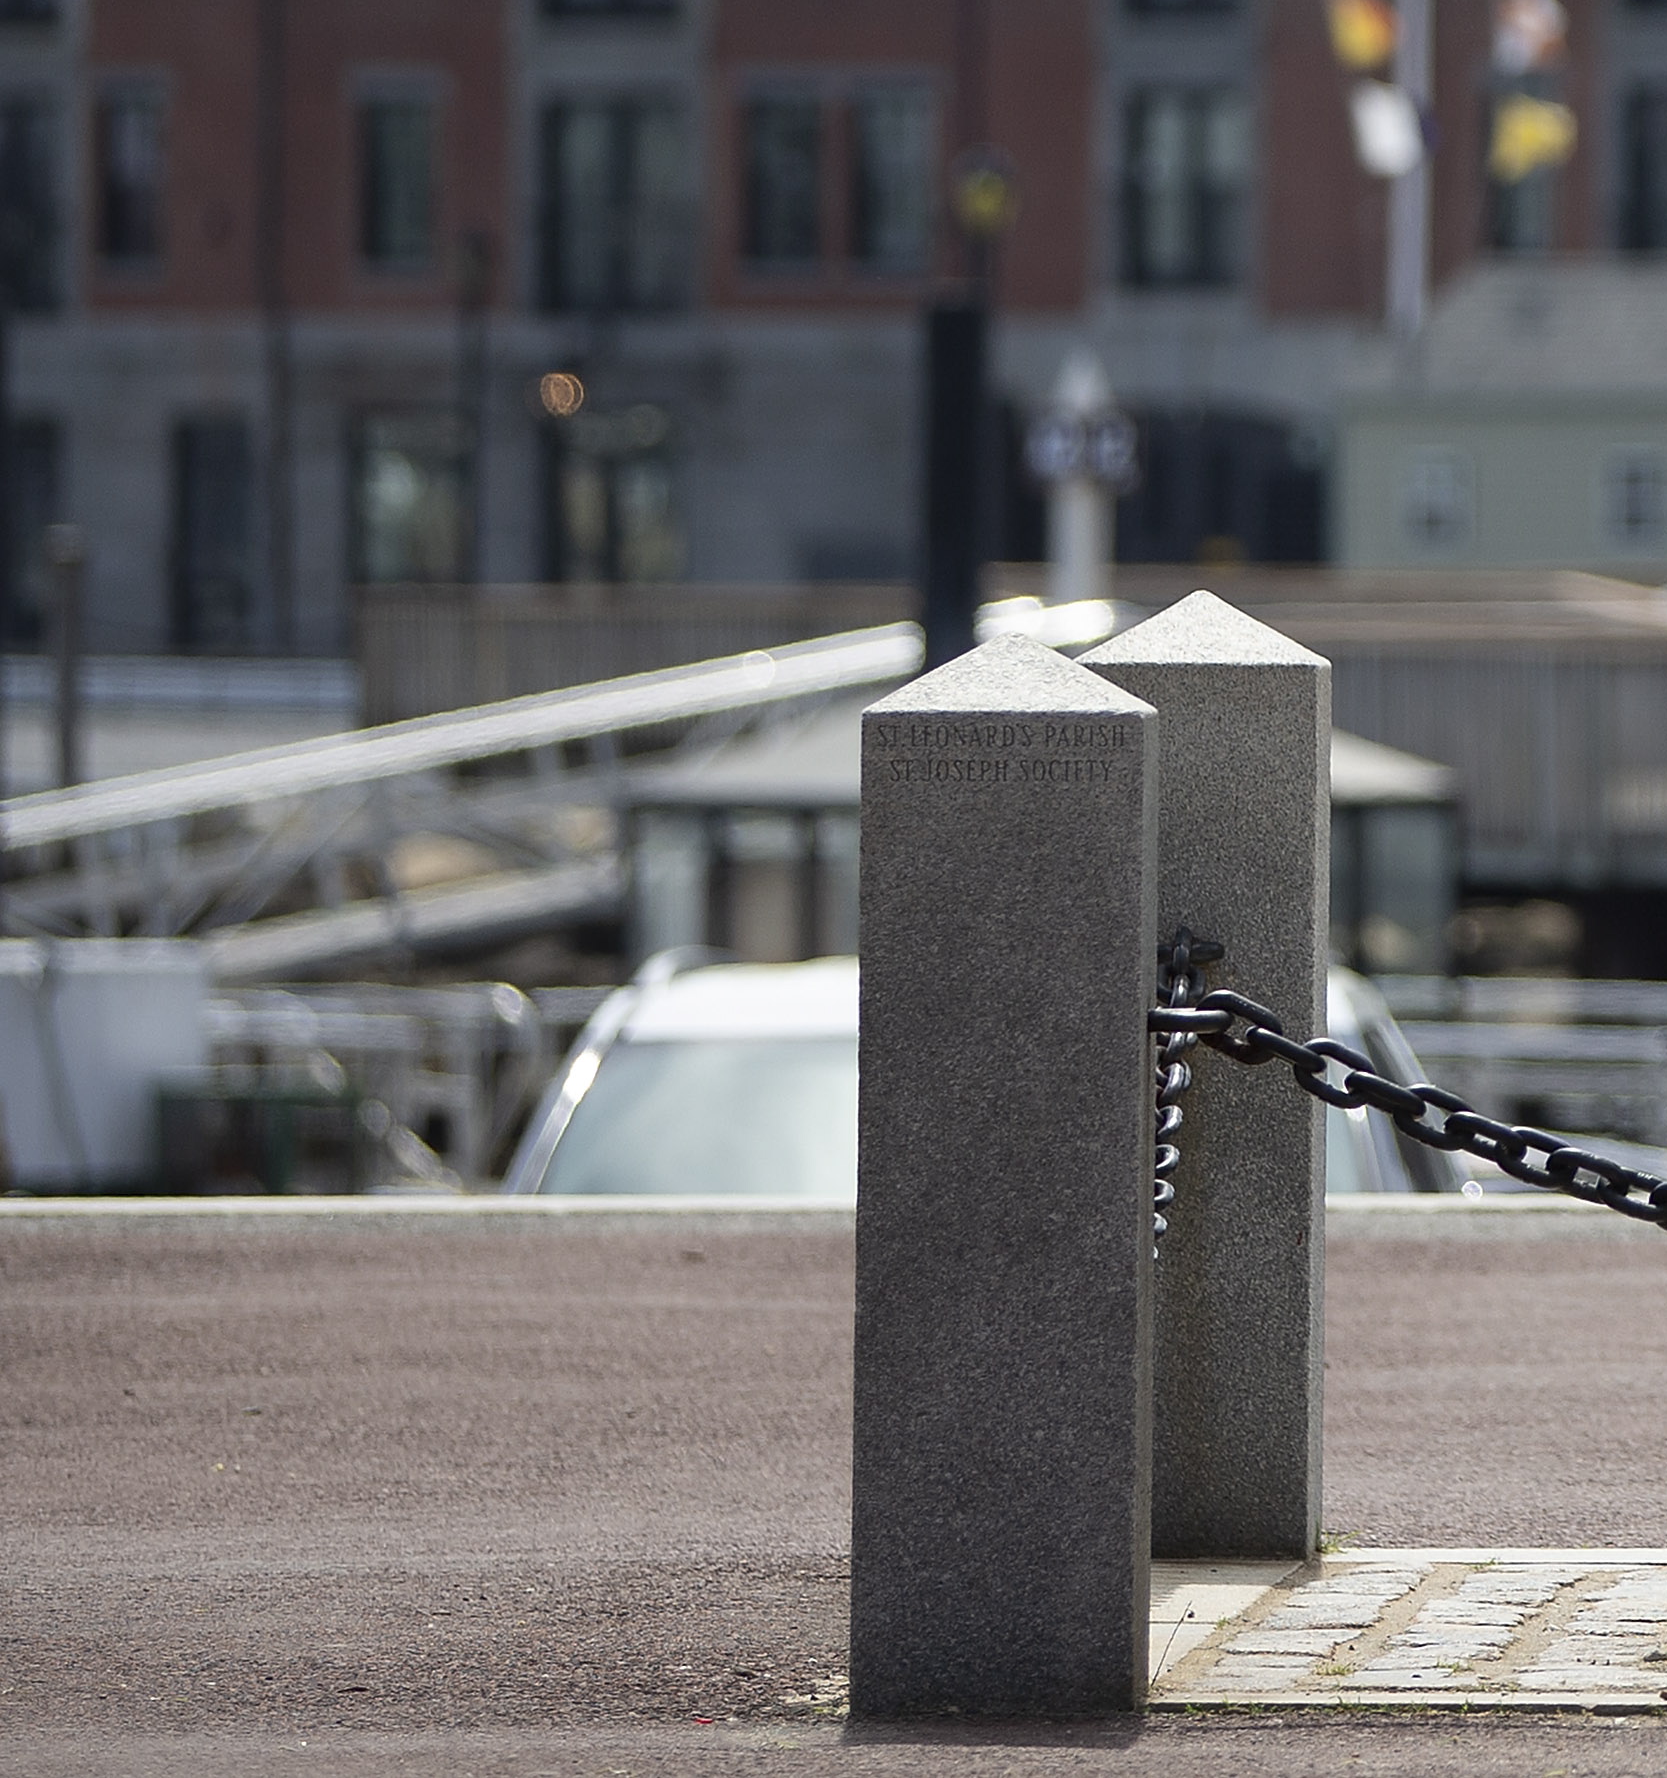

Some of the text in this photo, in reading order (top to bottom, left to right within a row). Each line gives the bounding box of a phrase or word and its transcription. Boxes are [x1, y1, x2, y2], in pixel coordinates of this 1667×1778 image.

[1045, 725, 1126, 748] PARISH
[926, 760, 1009, 782] JOSEPH
[1019, 760, 1115, 782] SOCIETY
